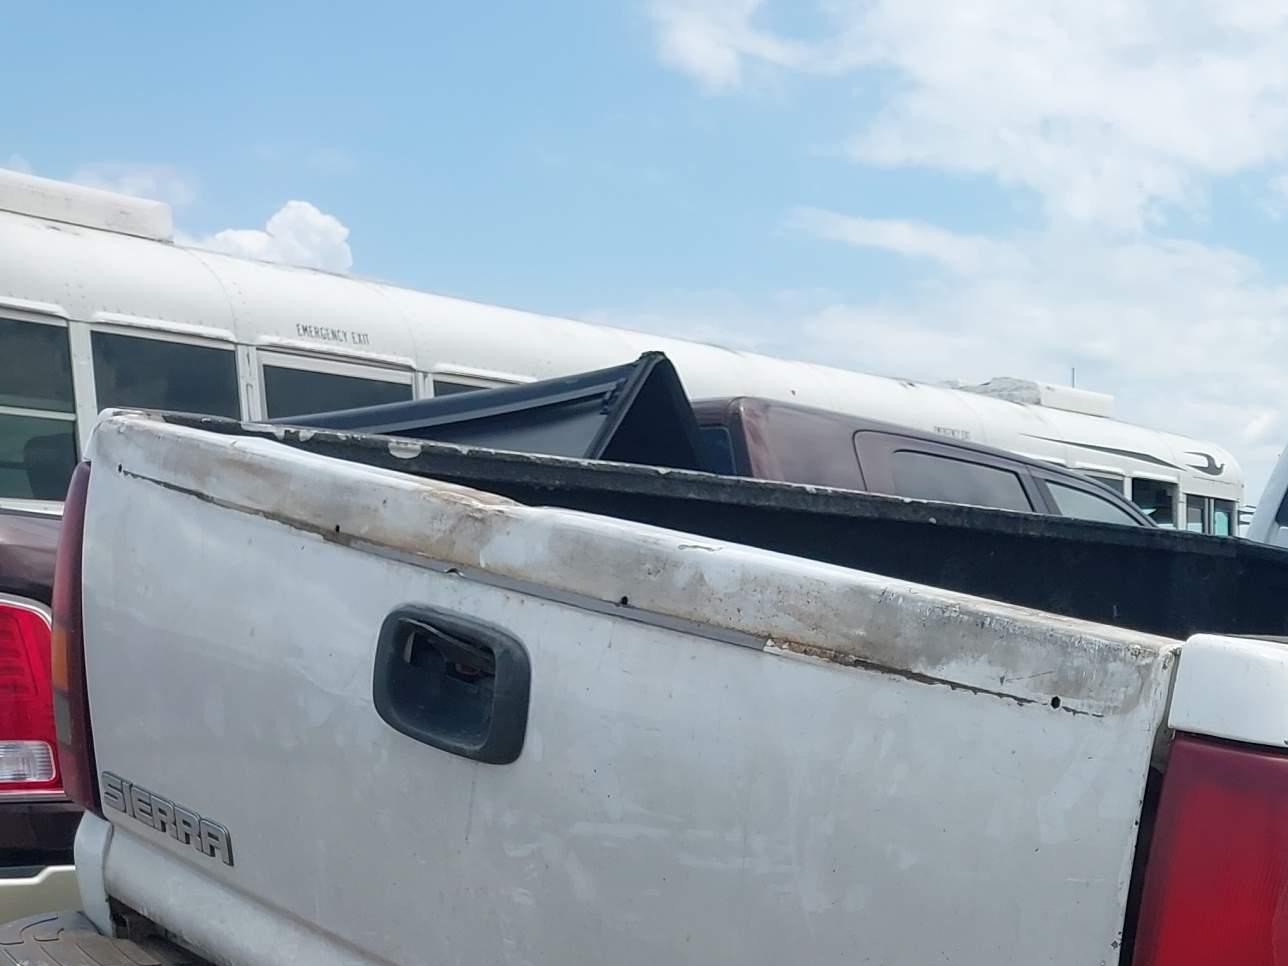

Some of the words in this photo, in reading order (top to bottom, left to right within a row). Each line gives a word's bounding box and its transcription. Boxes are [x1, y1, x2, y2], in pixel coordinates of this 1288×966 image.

[296, 323, 348, 342] EMERGENCY
[352, 332, 370, 345] EXIT
[101, 771, 234, 866] SIERRA
